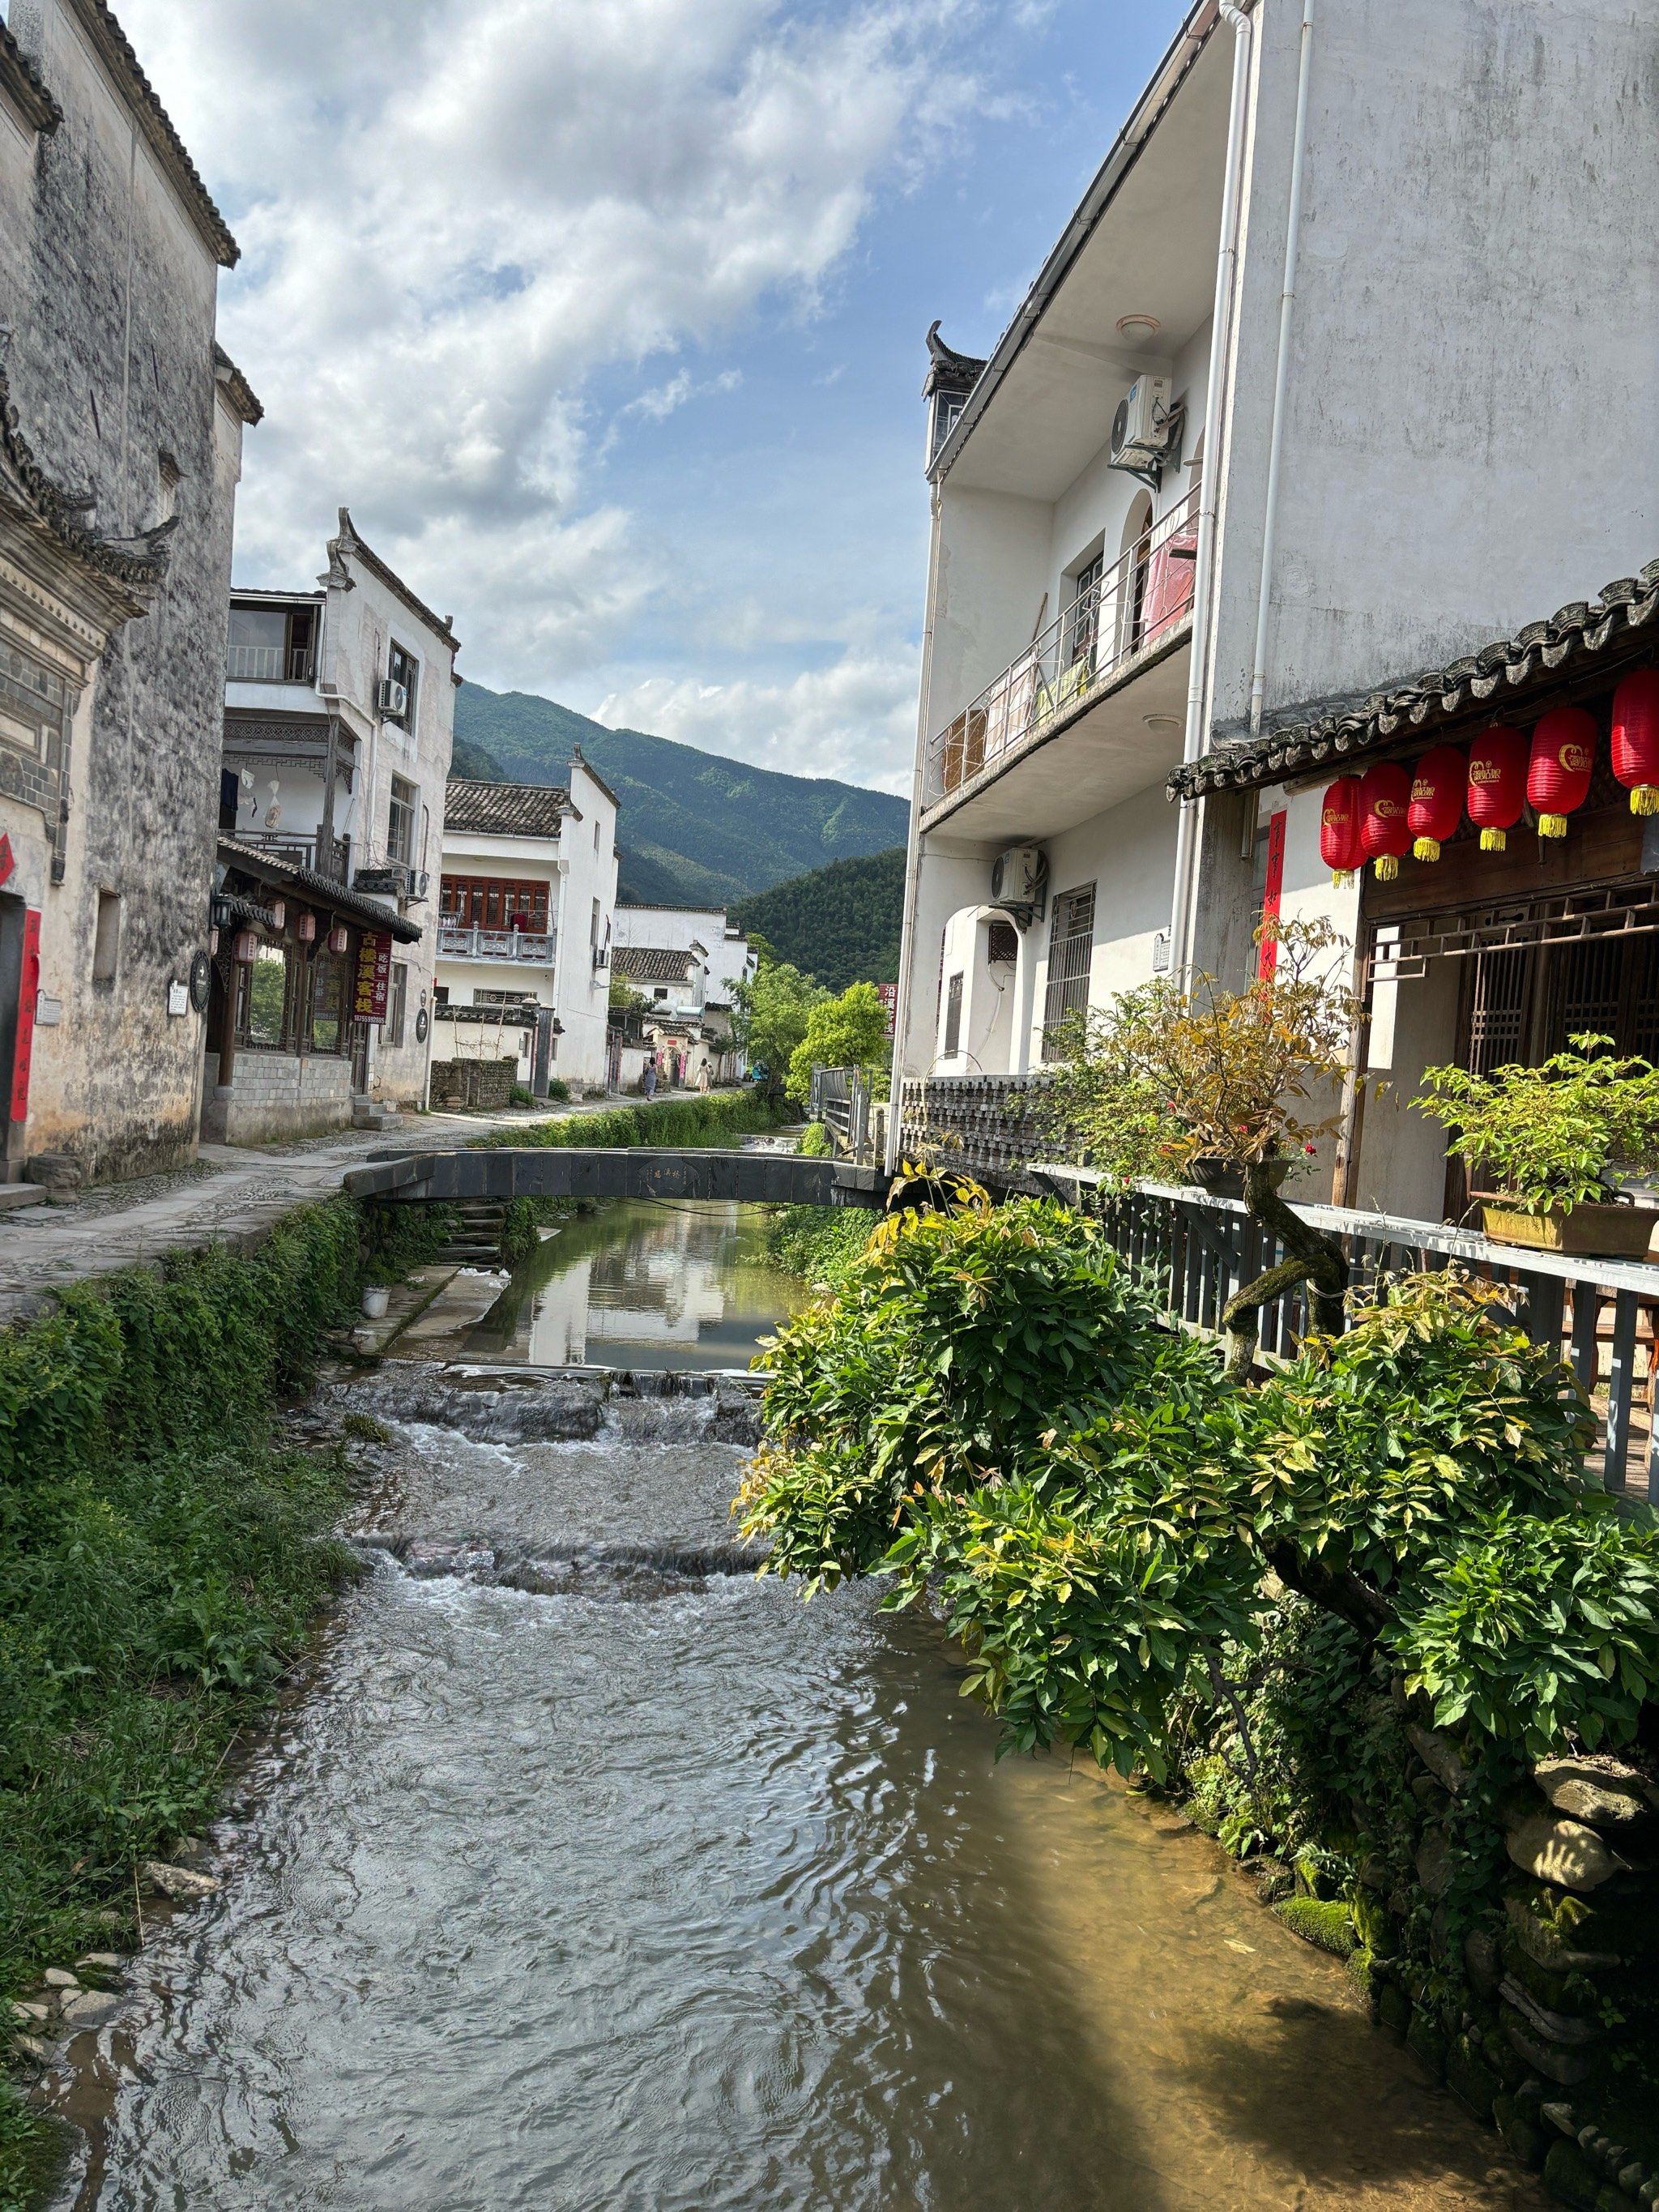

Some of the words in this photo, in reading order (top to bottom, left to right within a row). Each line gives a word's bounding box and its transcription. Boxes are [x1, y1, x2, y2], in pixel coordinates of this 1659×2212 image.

[355, 931, 378, 1014] 古楼溪客栈
